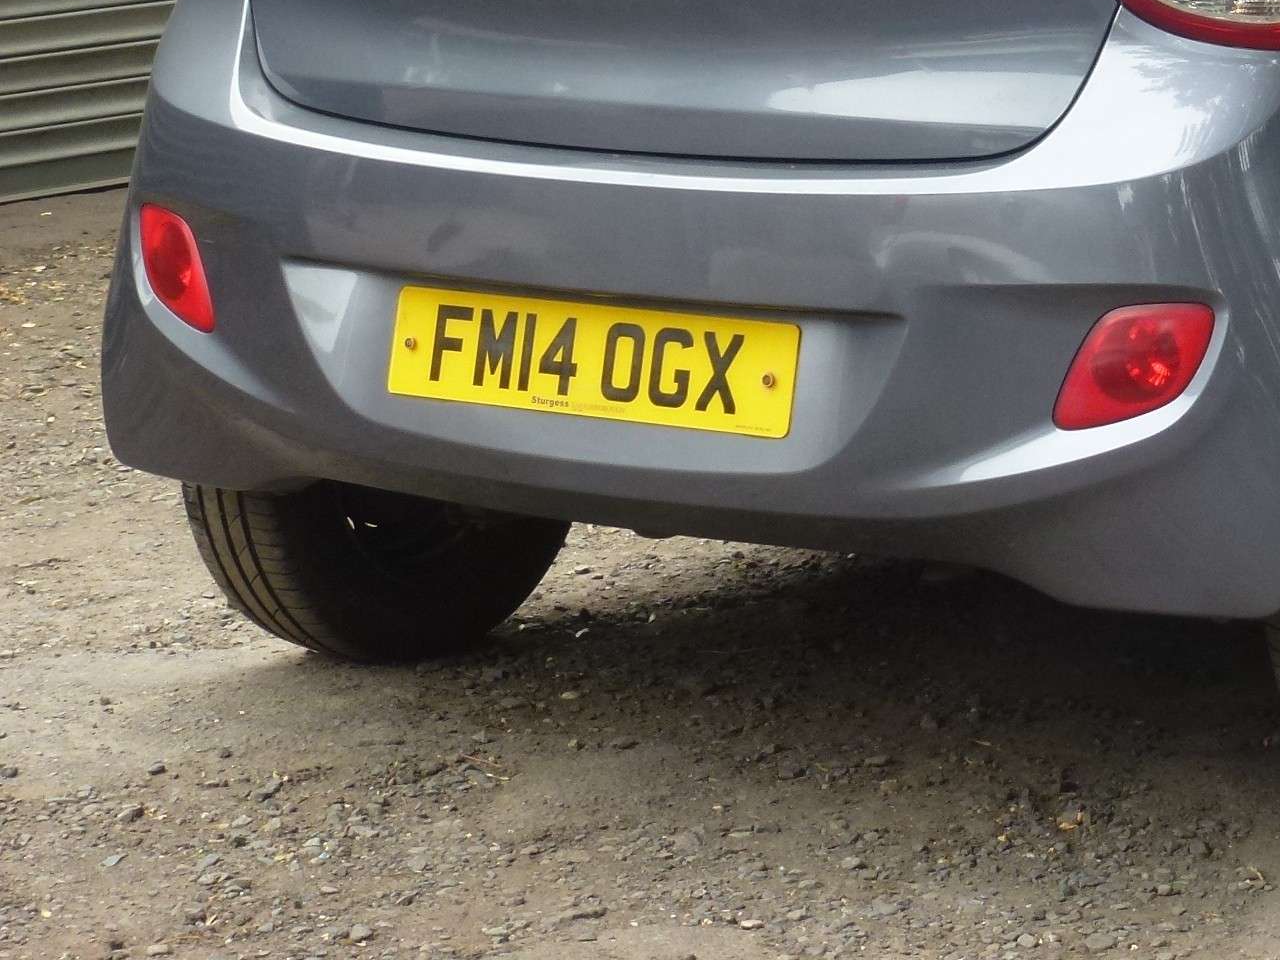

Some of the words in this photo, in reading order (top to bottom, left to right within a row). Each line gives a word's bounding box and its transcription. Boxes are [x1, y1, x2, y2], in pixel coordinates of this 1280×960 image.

[428, 303, 578, 397] FM14
[600, 321, 745, 415] OGX
[530, 395, 570, 408] Sturgess
